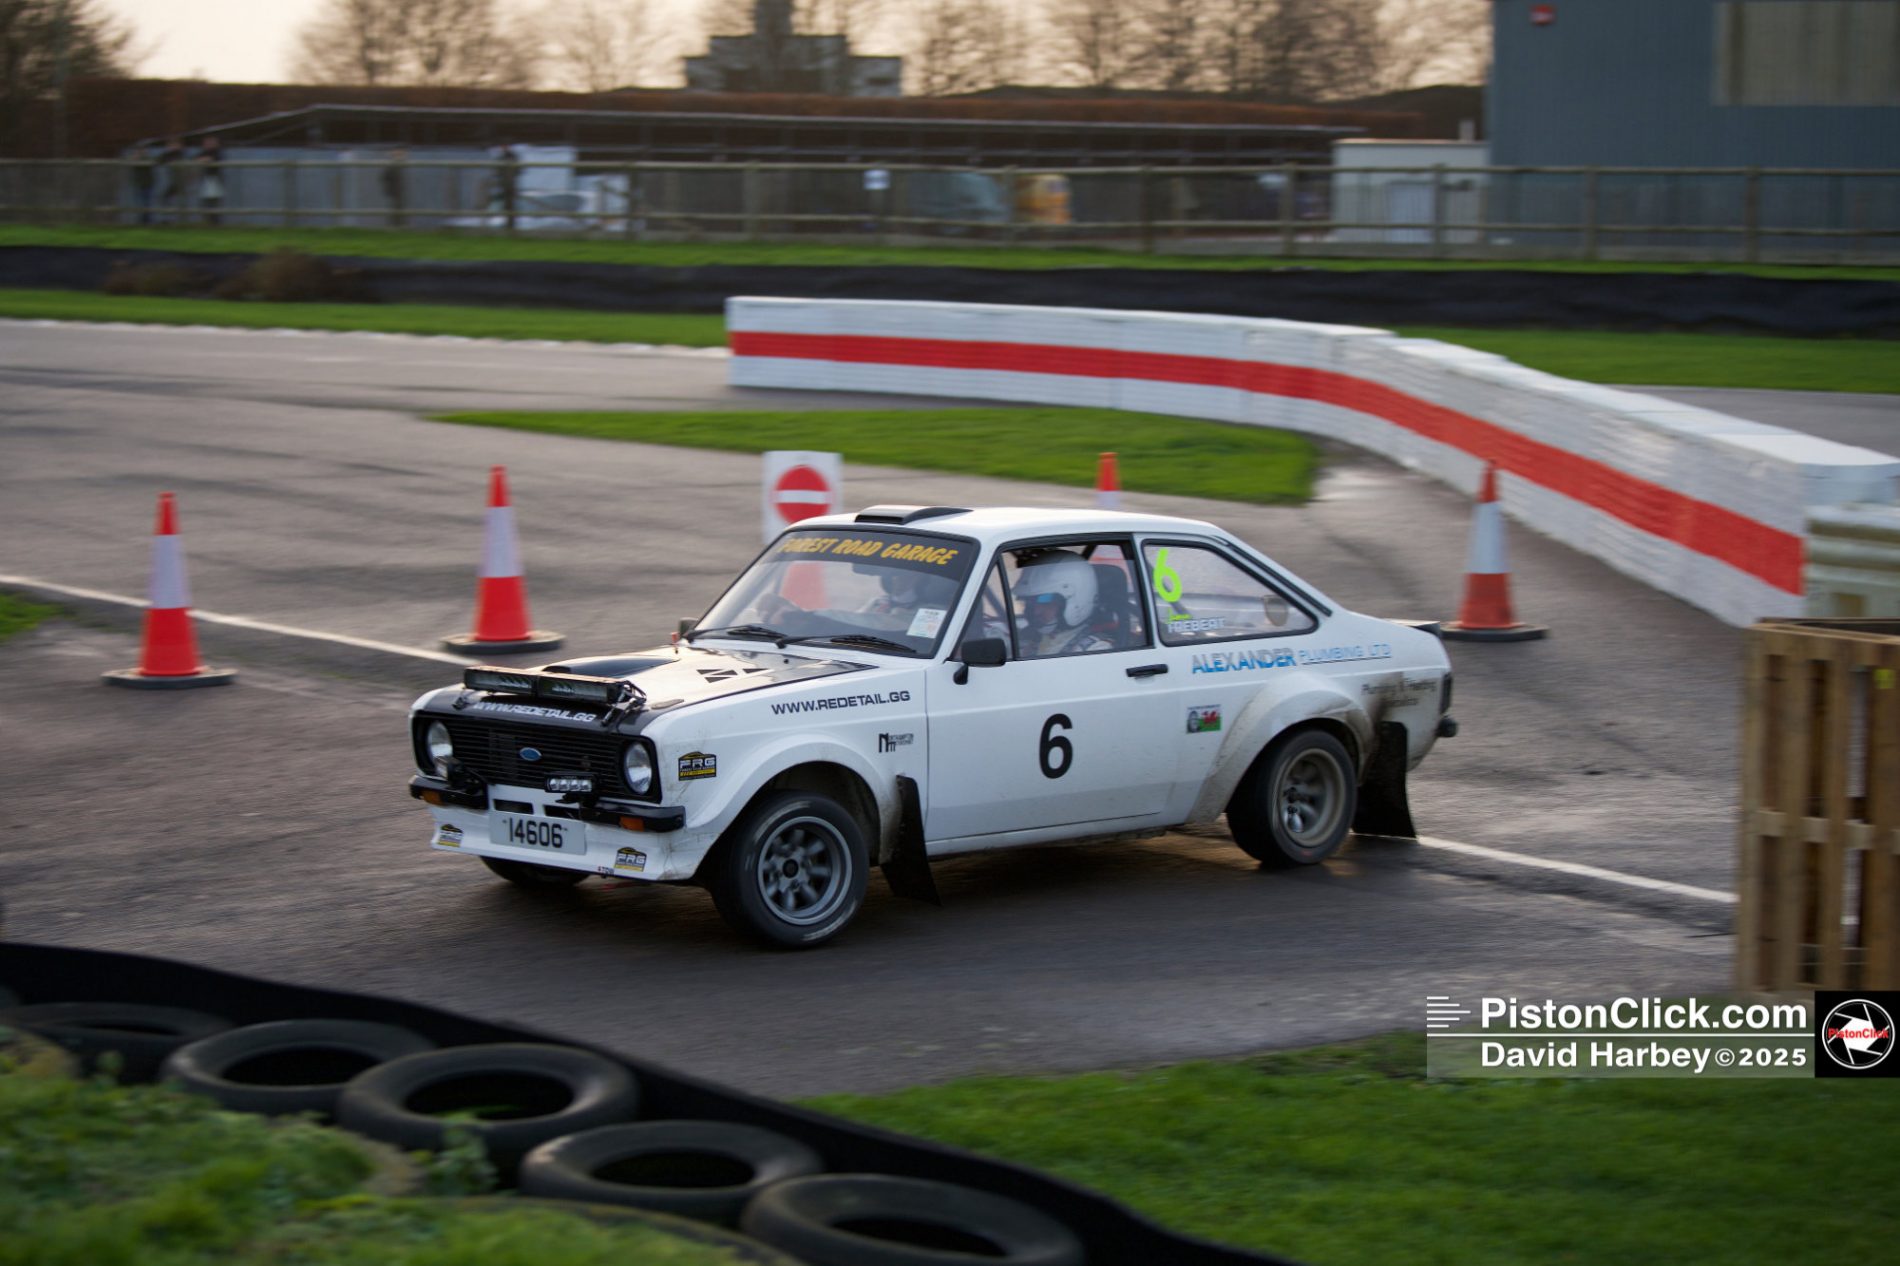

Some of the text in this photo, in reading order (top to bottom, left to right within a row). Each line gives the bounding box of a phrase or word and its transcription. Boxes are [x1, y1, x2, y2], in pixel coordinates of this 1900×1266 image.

[832, 539, 883, 556] ROAD
[880, 543, 958, 565] GARAGE
[1153, 548, 1182, 602] 6
[1191, 648, 1297, 674] ALEXANDER
[1368, 642, 1392, 657] LTD
[473, 702, 597, 722] WWW.REDETAIL.GG
[771, 690, 911, 715] WWW.REDETAIL.GG
[1039, 713, 1073, 779] 6
[509, 817, 563, 848] 14606
